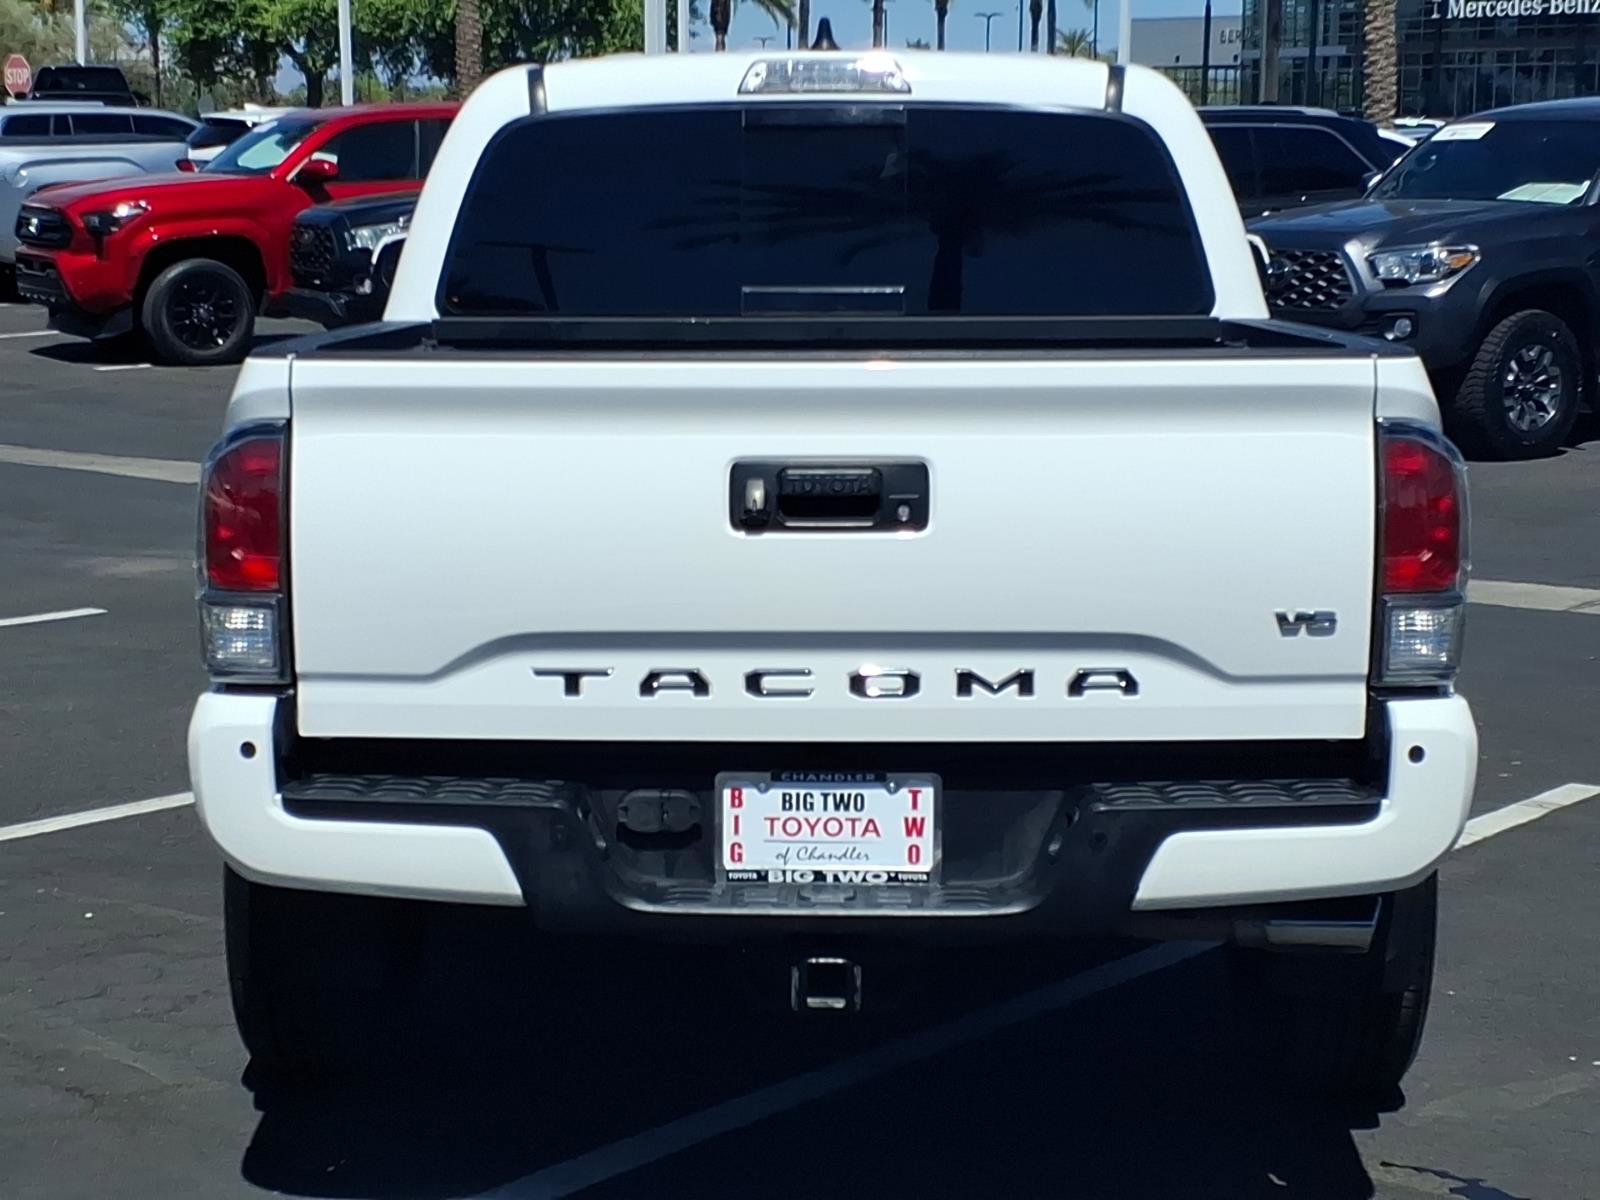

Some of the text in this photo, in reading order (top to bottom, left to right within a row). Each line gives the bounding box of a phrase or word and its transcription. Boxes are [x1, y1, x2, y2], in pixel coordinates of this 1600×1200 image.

[1446, 0, 1600, 19] Mercedes-Benz
[6, 68, 28, 85] STOP
[1274, 608, 1338, 638] V6
[531, 666, 1140, 699] TACOMA
[780, 772, 876, 782] CHANDLER
[781, 792, 865, 812] BIG TWO
[763, 816, 882, 838] TOYOTA
[775, 845, 870, 865] of Chandler
[728, 872, 758, 880] TOYOTA
[767, 870, 815, 884] BIG
[823, 870, 889, 884] TWO
